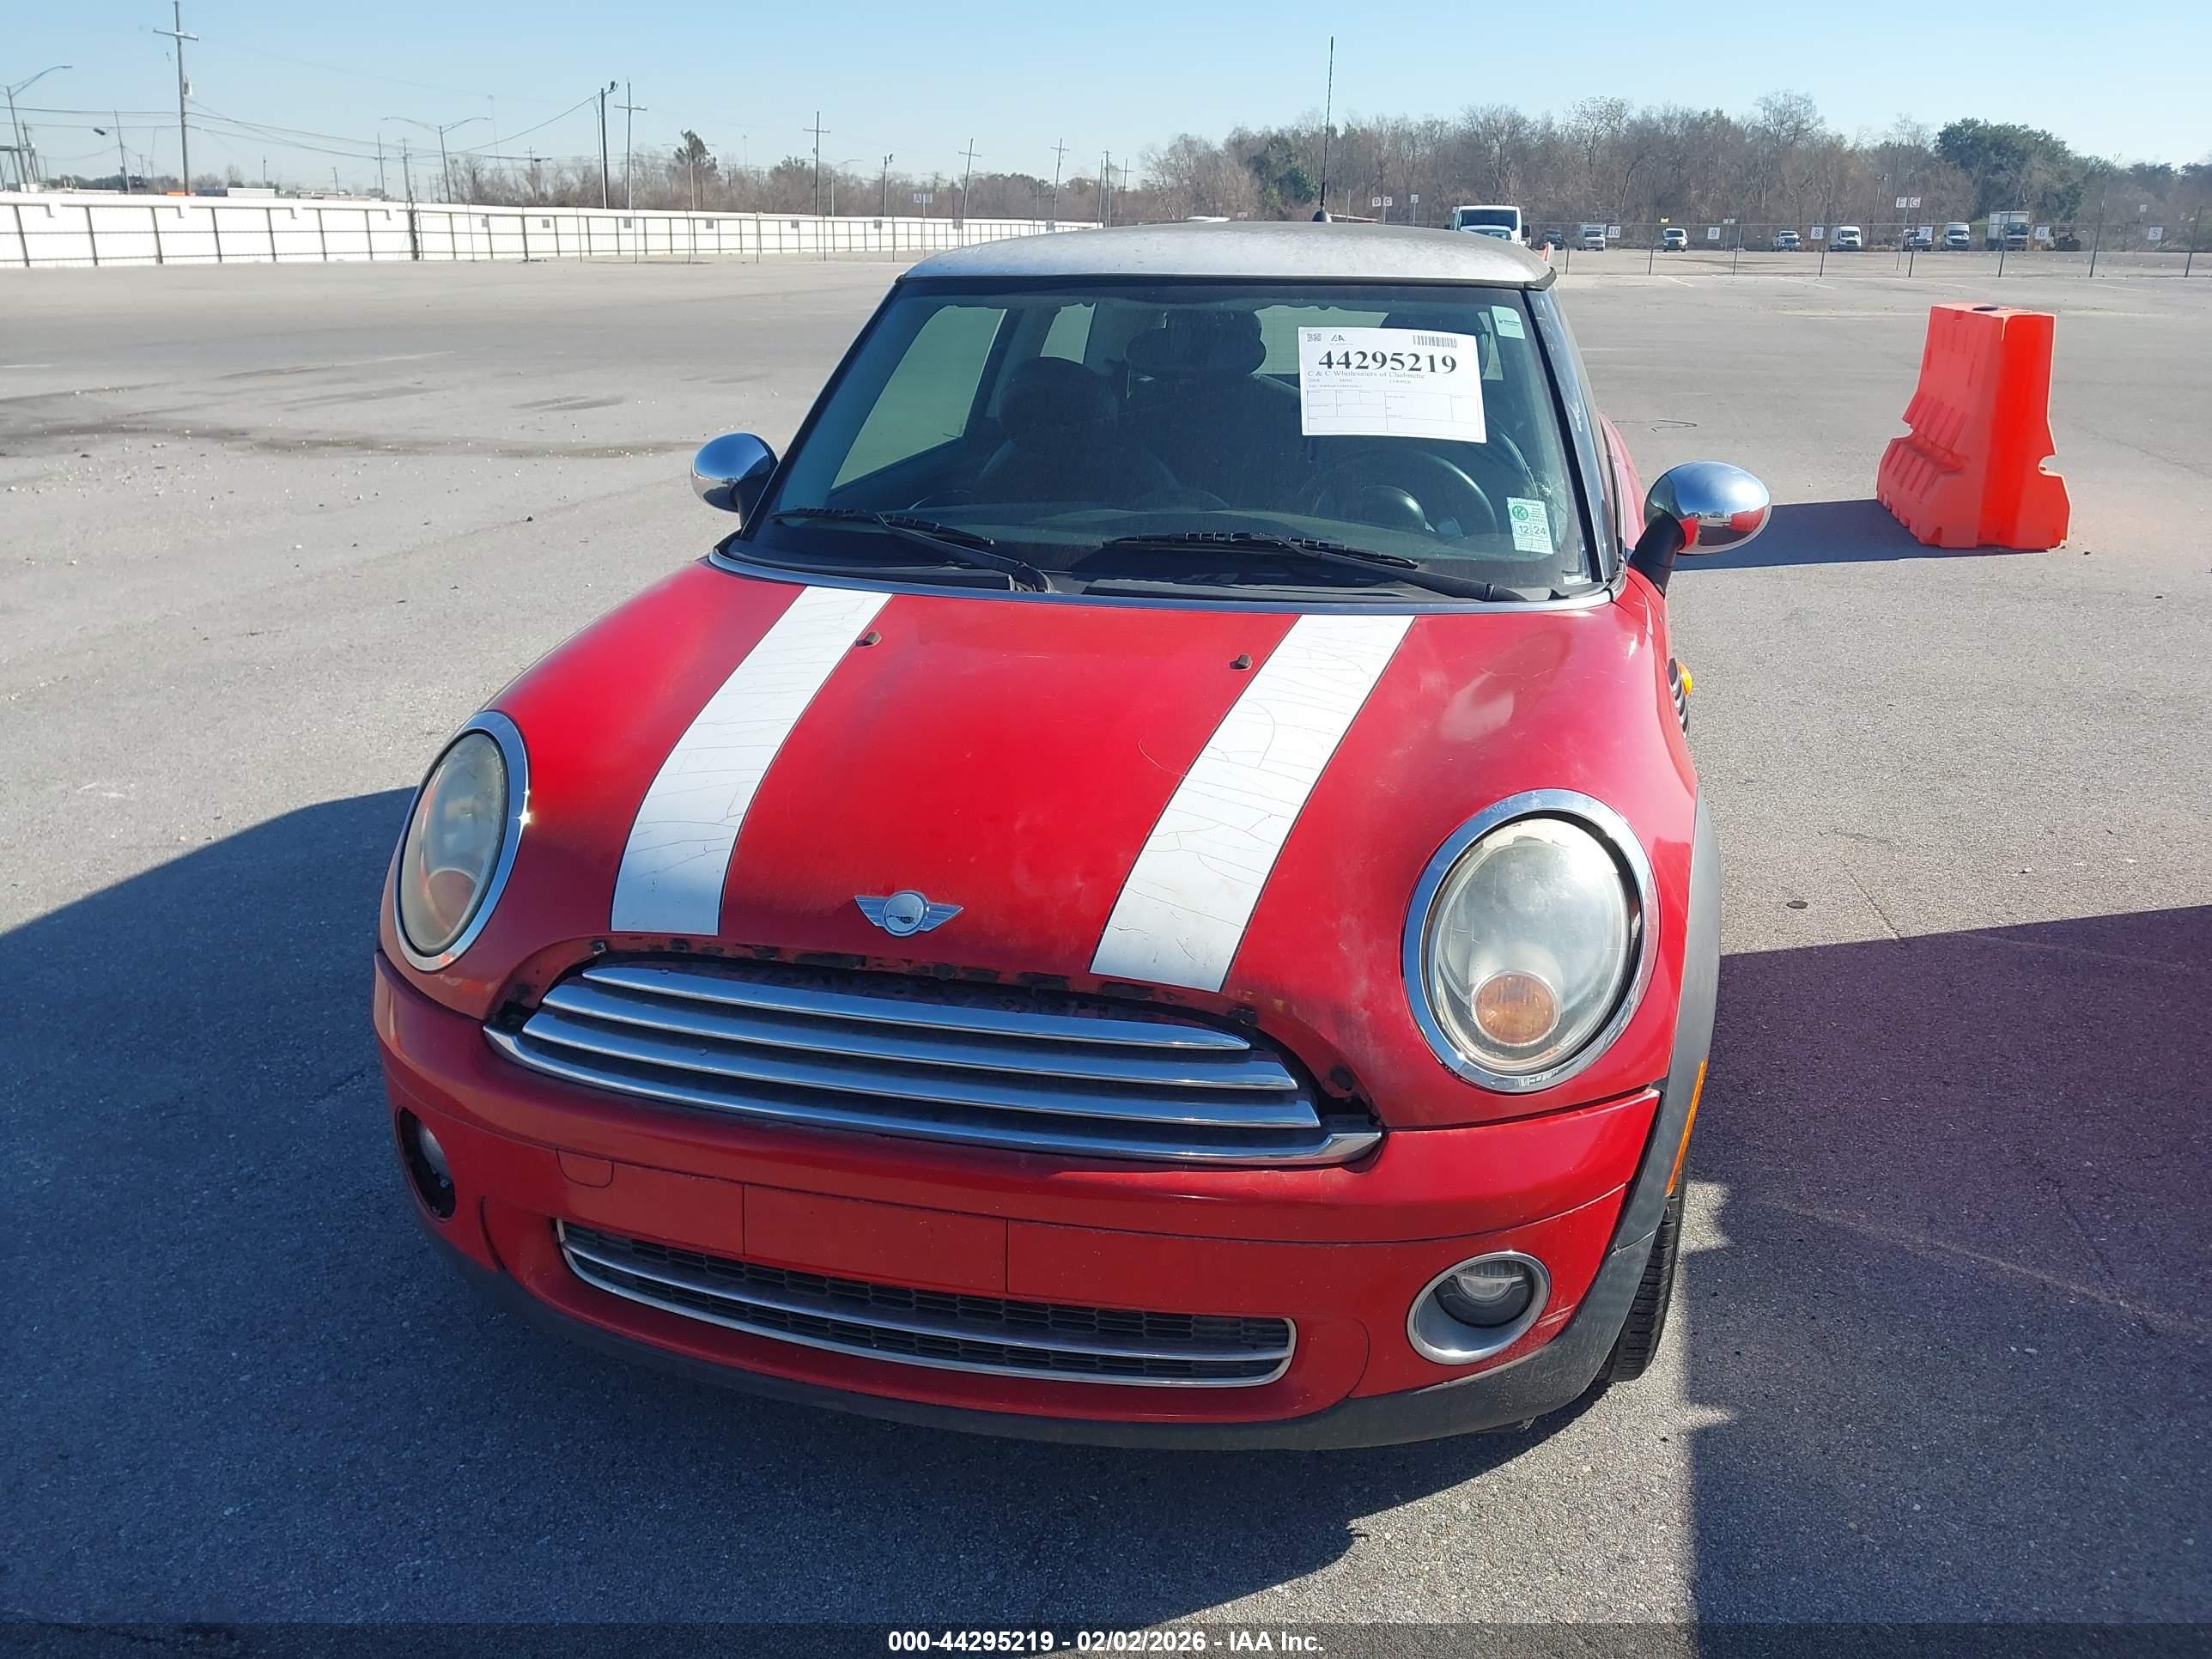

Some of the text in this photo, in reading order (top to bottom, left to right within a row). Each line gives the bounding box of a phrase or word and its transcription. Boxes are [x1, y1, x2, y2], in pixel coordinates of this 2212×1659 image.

[1911, 198, 1918, 206] G
[1609, 228, 1620, 236] 10
[1814, 228, 1820, 237] 8
[1318, 350, 1457, 374] 44295219
[1519, 526, 1529, 534] 12
[1533, 526, 1546, 535] 24
